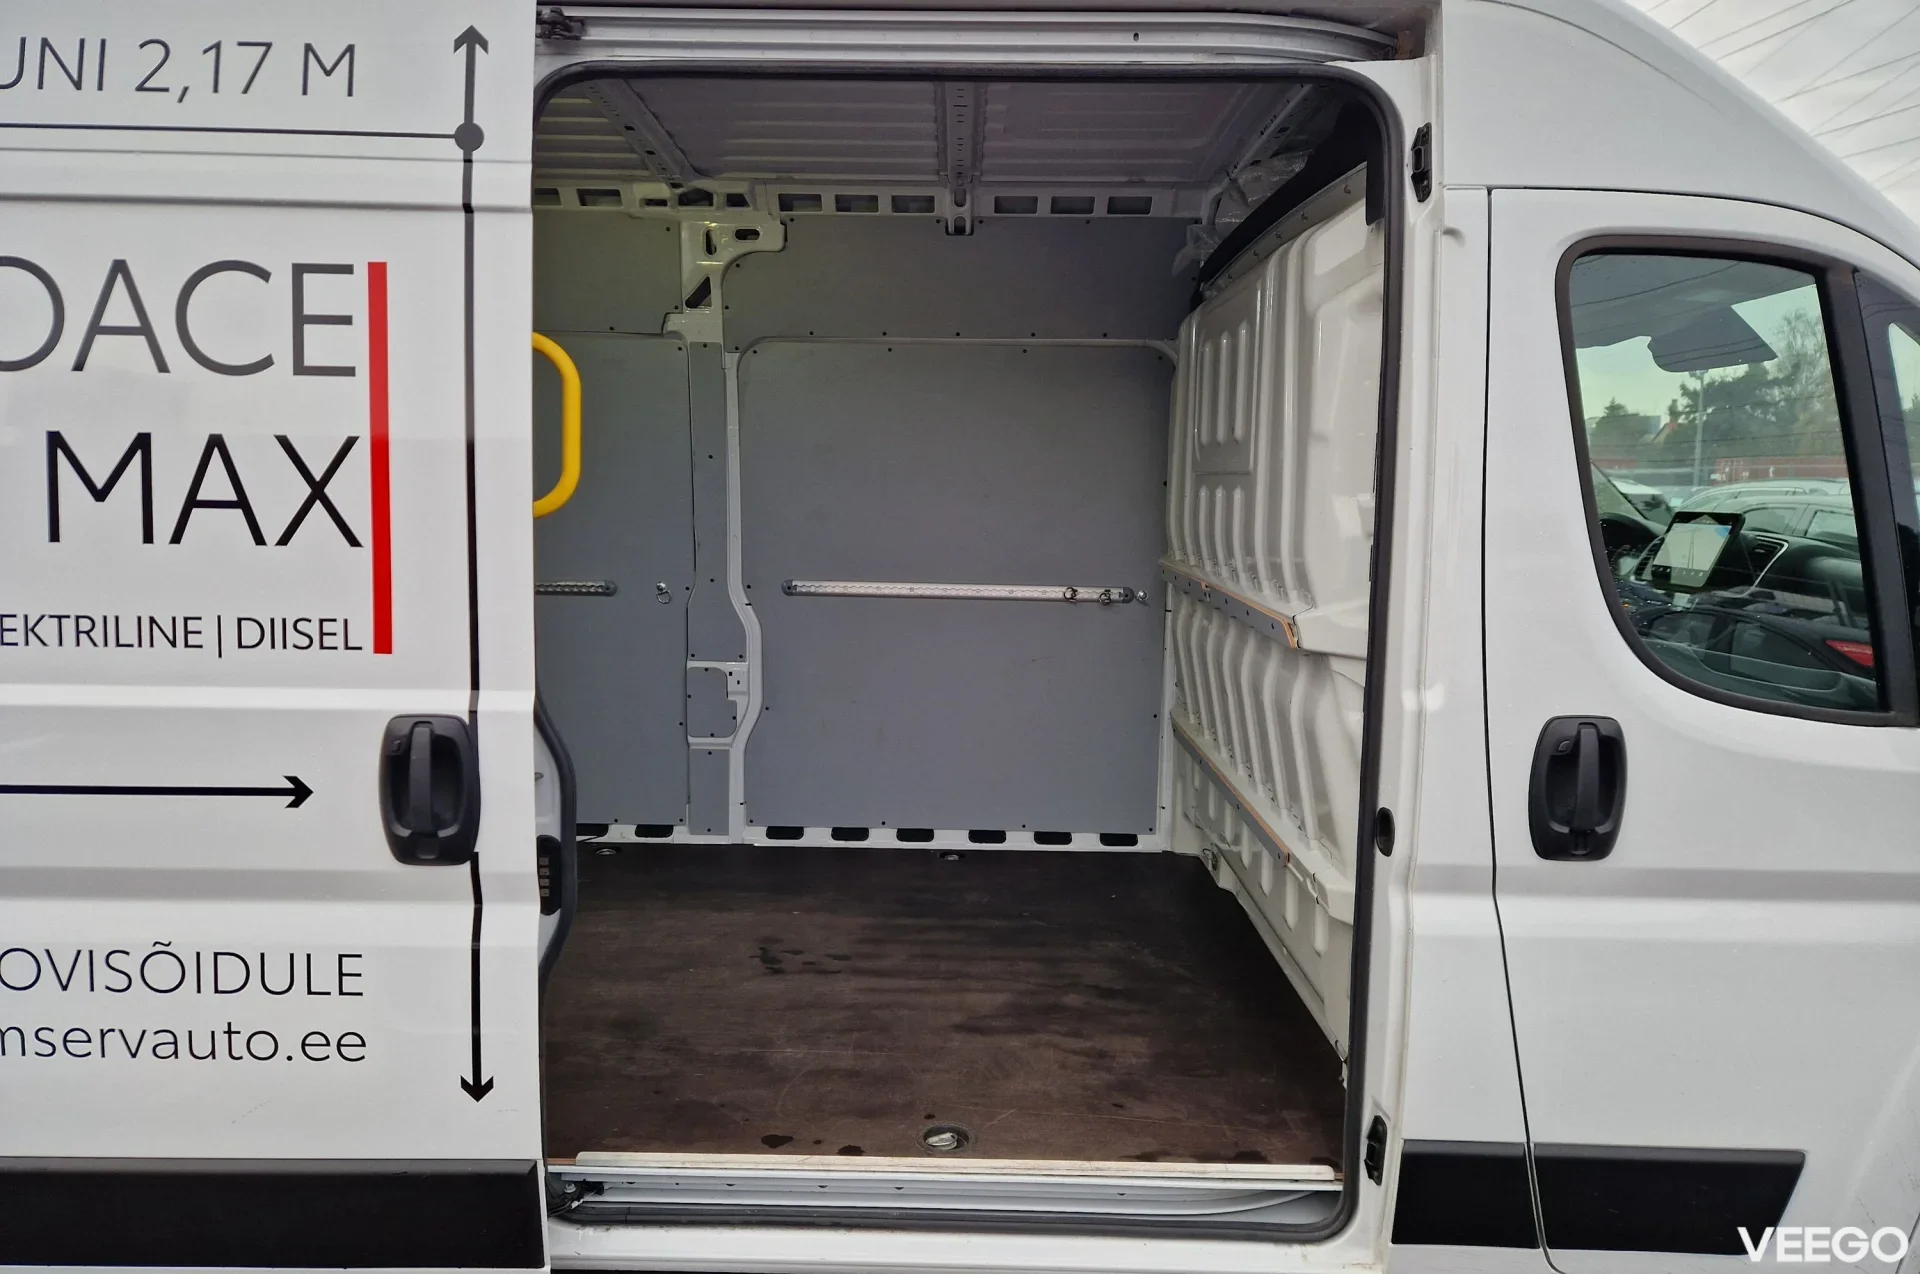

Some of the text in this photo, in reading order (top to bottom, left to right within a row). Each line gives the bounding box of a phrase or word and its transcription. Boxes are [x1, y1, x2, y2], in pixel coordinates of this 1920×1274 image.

[134, 38, 274, 104] 2,17
[301, 42, 356, 98] M
[45, 429, 364, 549] MAX
[236, 616, 363, 651] DIISEL
[0, 940, 364, 997] OVISÕIDULE
